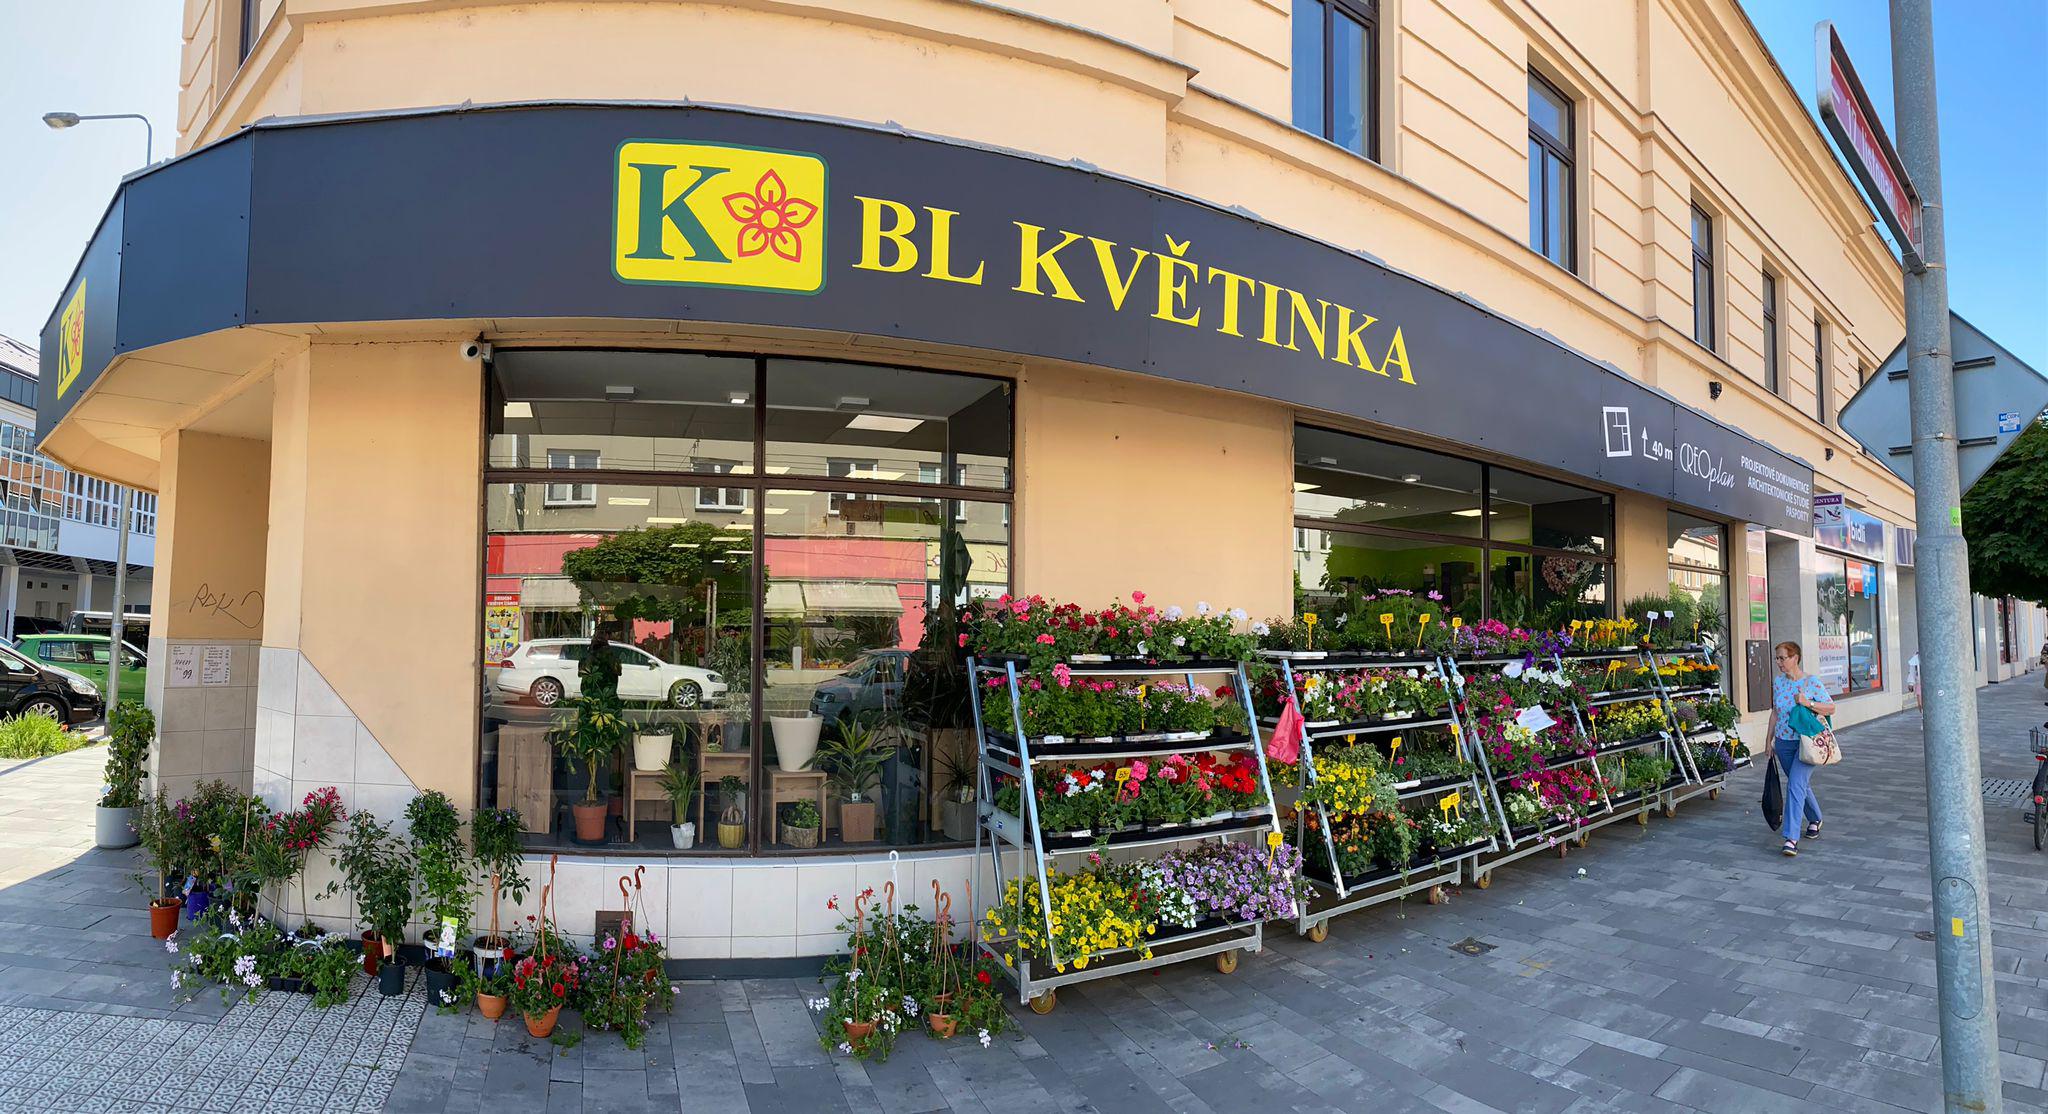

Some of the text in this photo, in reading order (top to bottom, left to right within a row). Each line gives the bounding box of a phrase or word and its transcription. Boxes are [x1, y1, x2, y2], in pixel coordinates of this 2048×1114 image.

[624, 162, 732, 264] K
[851, 195, 1417, 385] BL KVĚTINKA
[1652, 440, 1673, 461] 40 m
[1680, 442, 1736, 492] CREOplan
[1740, 455, 1810, 495] PROJEKTOVÉ DOKUMENTACE
[1747, 476, 1810, 510] ARCHITEKTONICKÉ STUDIE
[1785, 505, 1809, 523] PASPORTY
[1851, 521, 1866, 543] bidli
